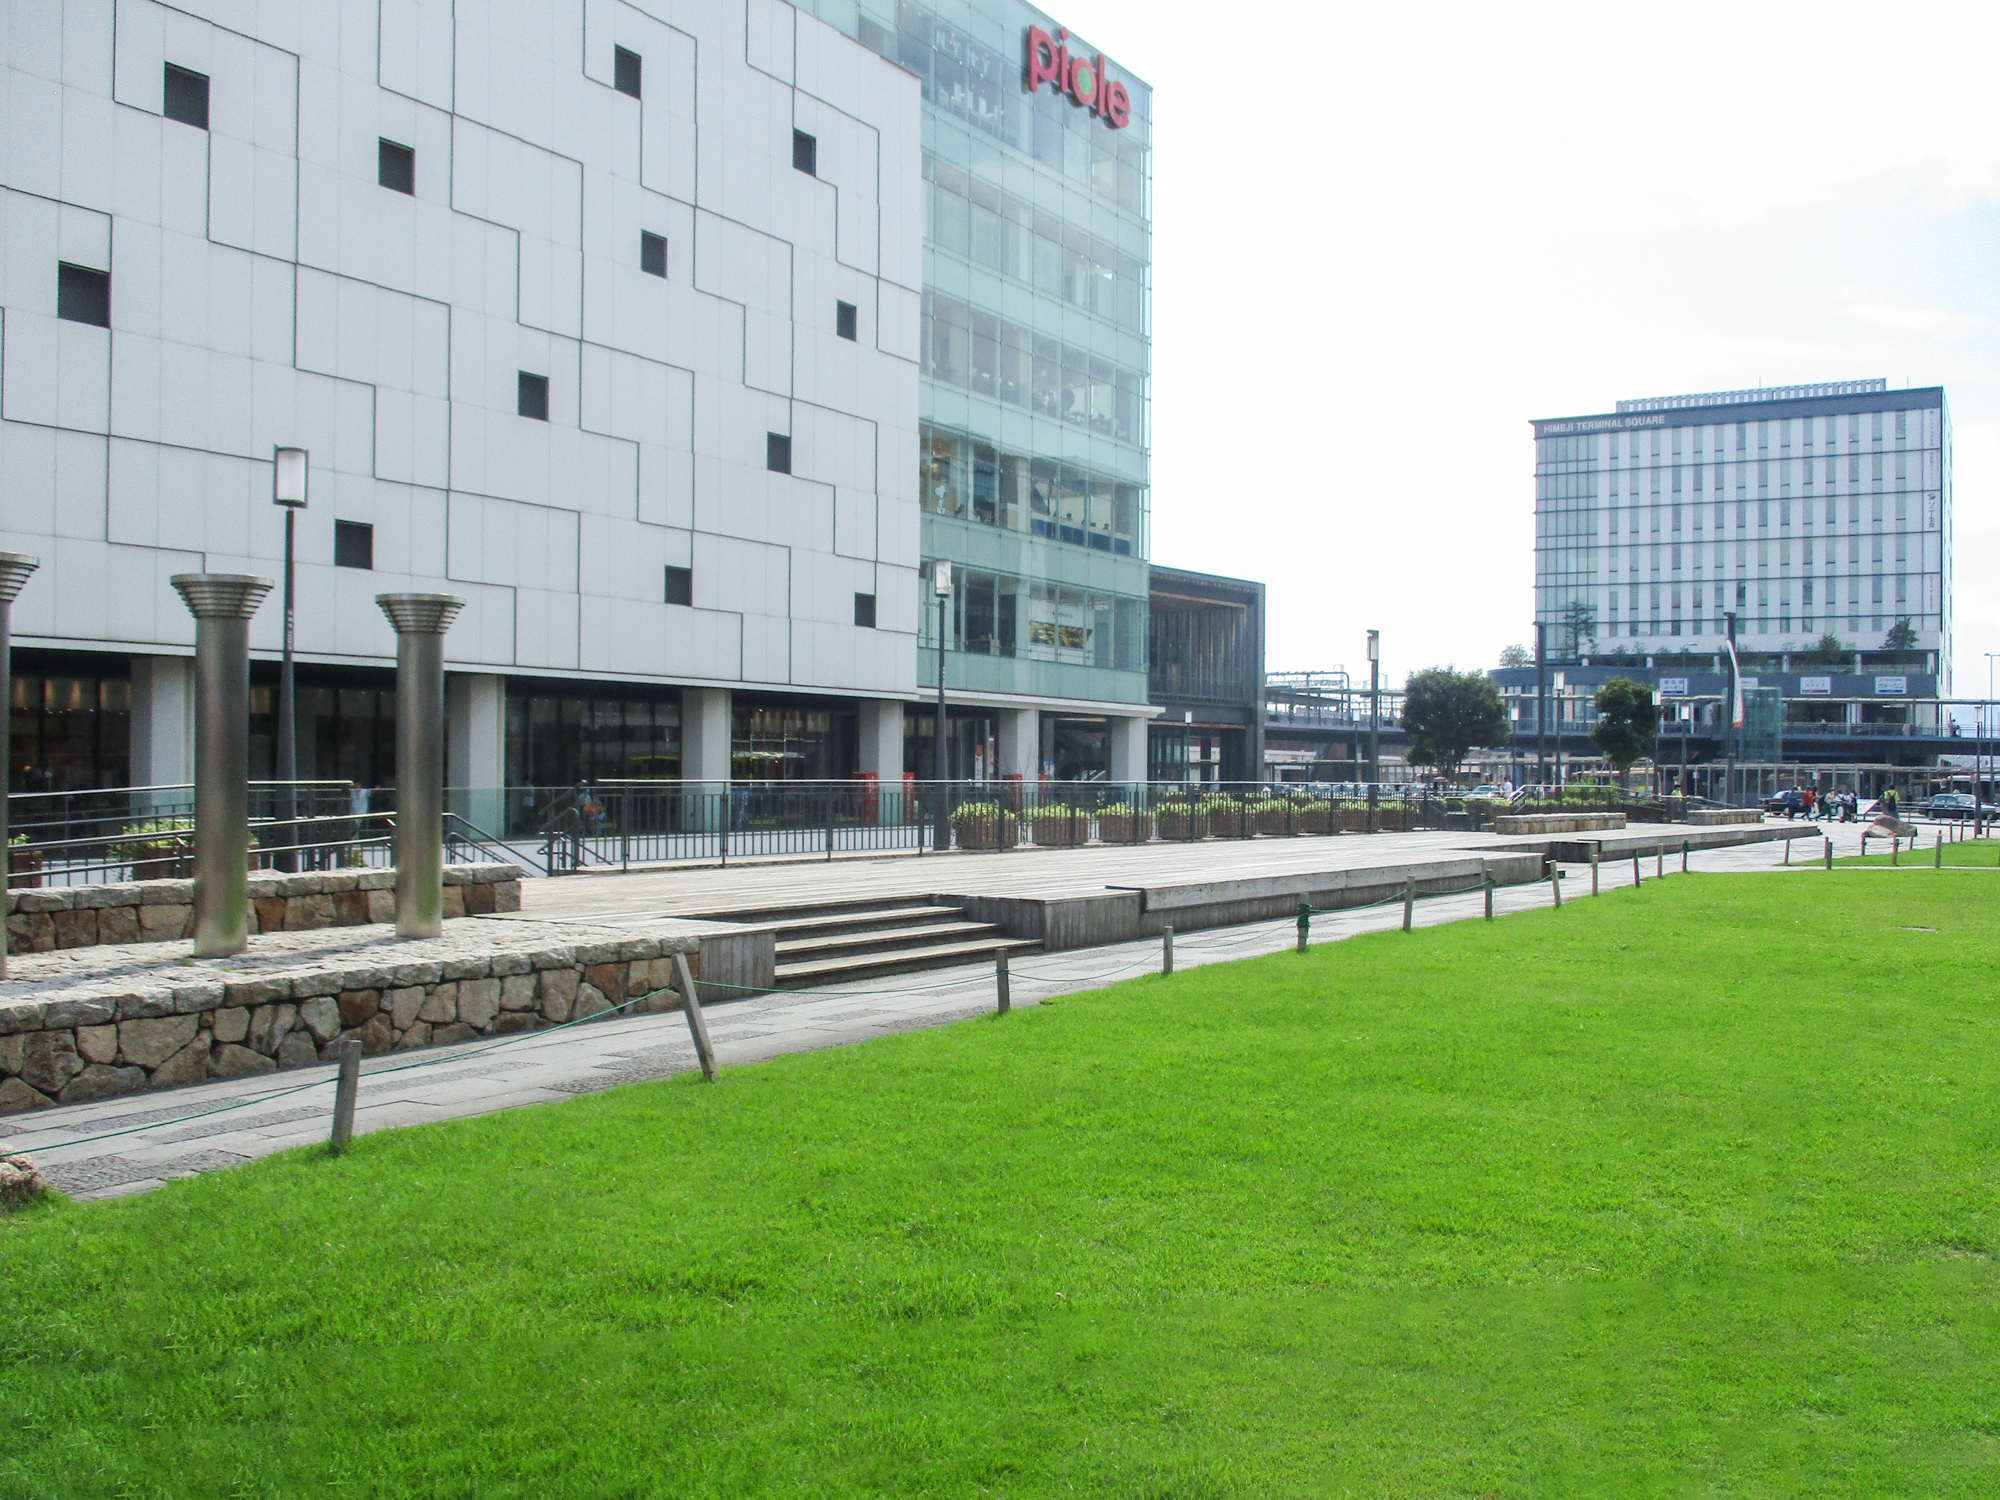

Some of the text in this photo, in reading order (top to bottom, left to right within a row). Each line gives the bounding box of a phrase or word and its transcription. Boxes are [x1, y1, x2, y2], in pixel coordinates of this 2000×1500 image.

[1028, 24, 1130, 128] piole
[1544, 415, 1665, 433] HIMEJI TERMINAL SQUARE
